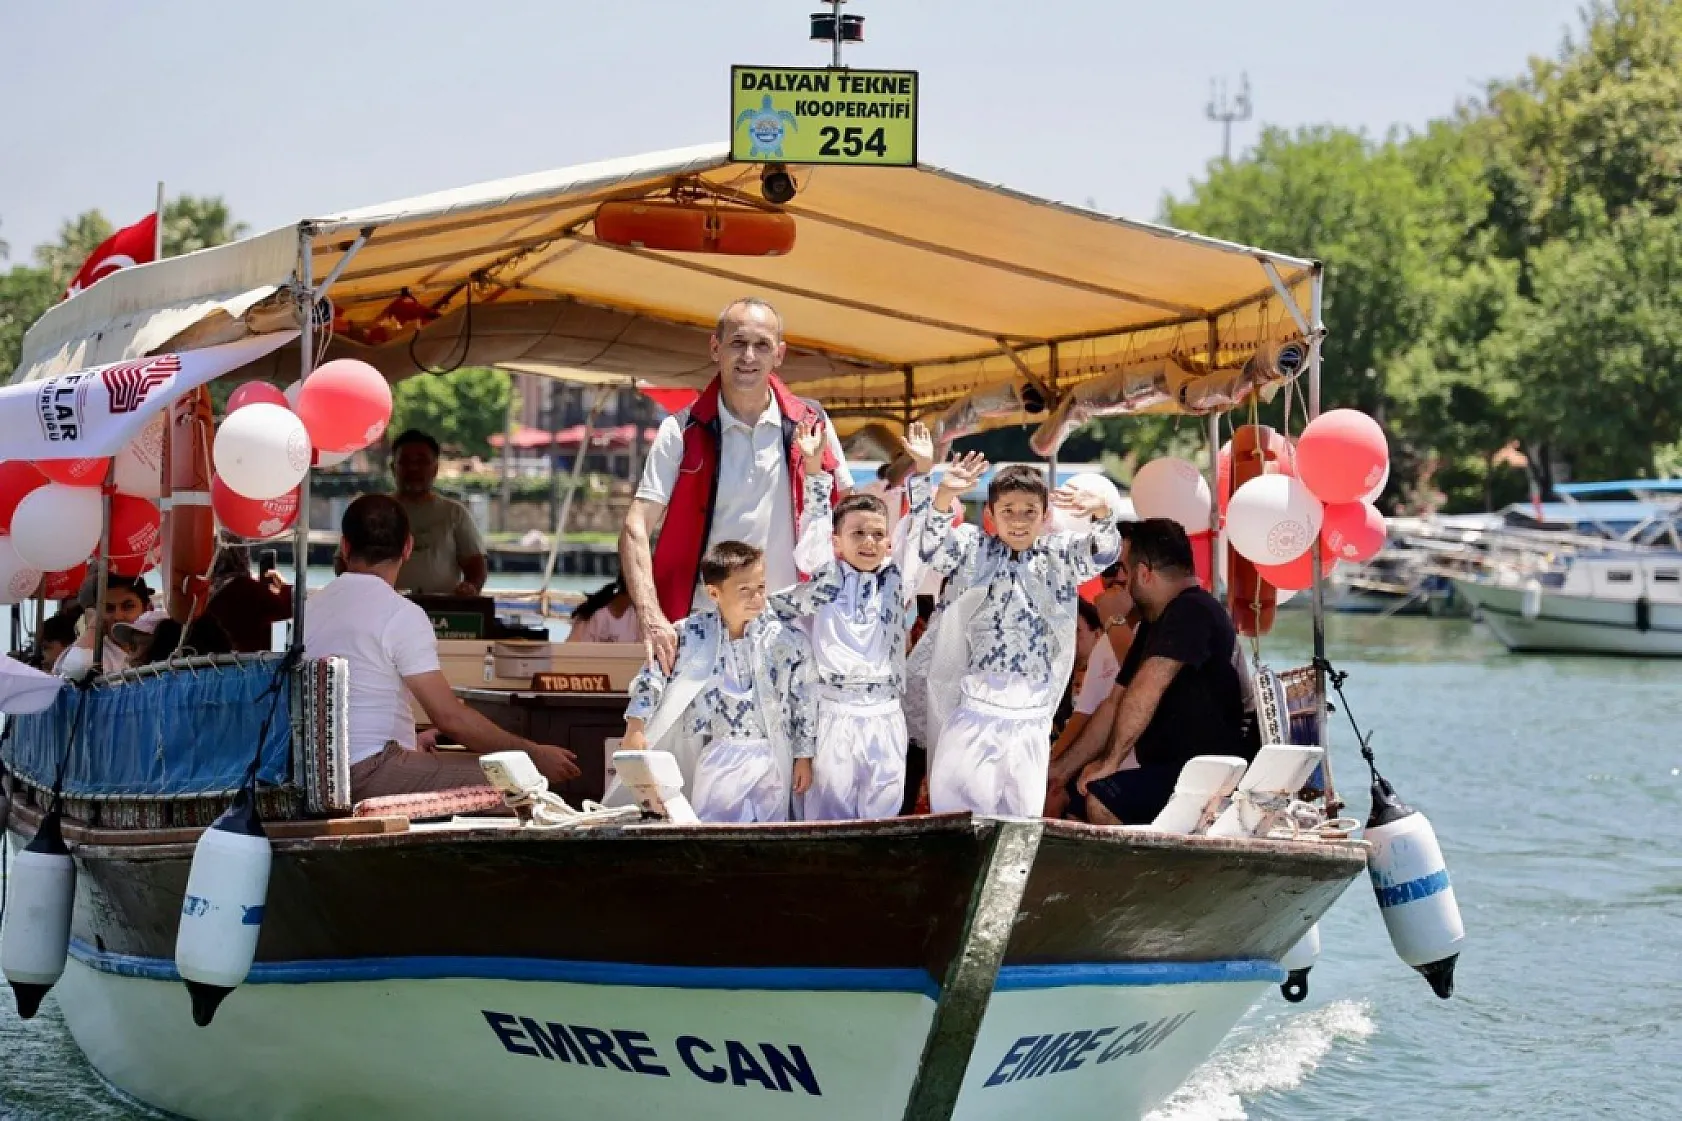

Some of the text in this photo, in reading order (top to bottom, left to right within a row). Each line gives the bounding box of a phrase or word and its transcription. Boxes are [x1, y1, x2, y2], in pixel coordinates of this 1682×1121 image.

[741, 72, 911, 94] DALYAN TEKNE
[795, 99, 910, 119] KOOPERATİFİ
[818, 125, 887, 157] 254
[541, 676, 604, 691] TIP BOX
[481, 1009, 822, 1096] EMRE CAN
[983, 1010, 1196, 1088] EMRE CAN
